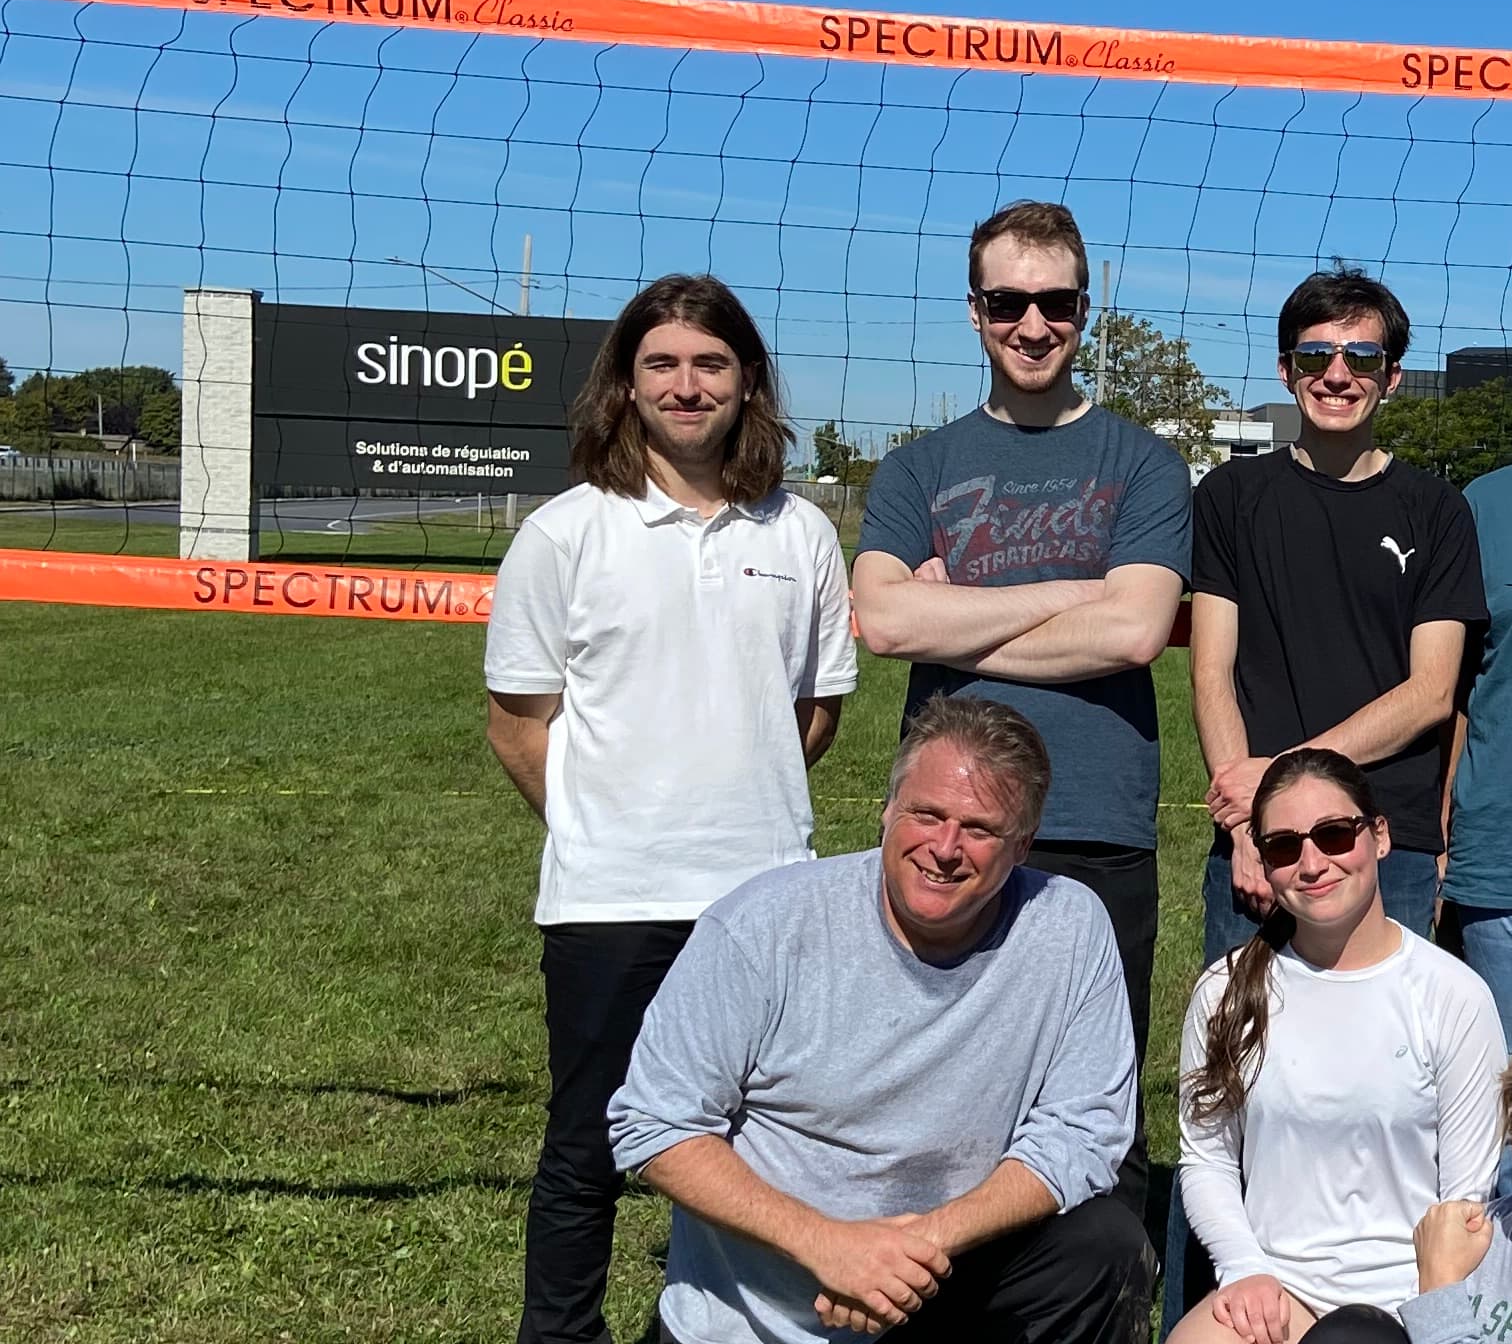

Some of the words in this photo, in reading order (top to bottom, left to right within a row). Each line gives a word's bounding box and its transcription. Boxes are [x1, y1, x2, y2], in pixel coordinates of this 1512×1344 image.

[1082, 41, 1176, 74] Classic
[356, 335, 534, 400] sinopé
[355, 441, 428, 457] Solutions
[431, 444, 451, 458] de
[454, 445, 530, 463] régulation
[372, 460, 385, 473] &
[388, 462, 513, 478] d'automatisation
[1003, 481, 1040, 496] Since
[966, 540, 1106, 581] STRATOCAS
